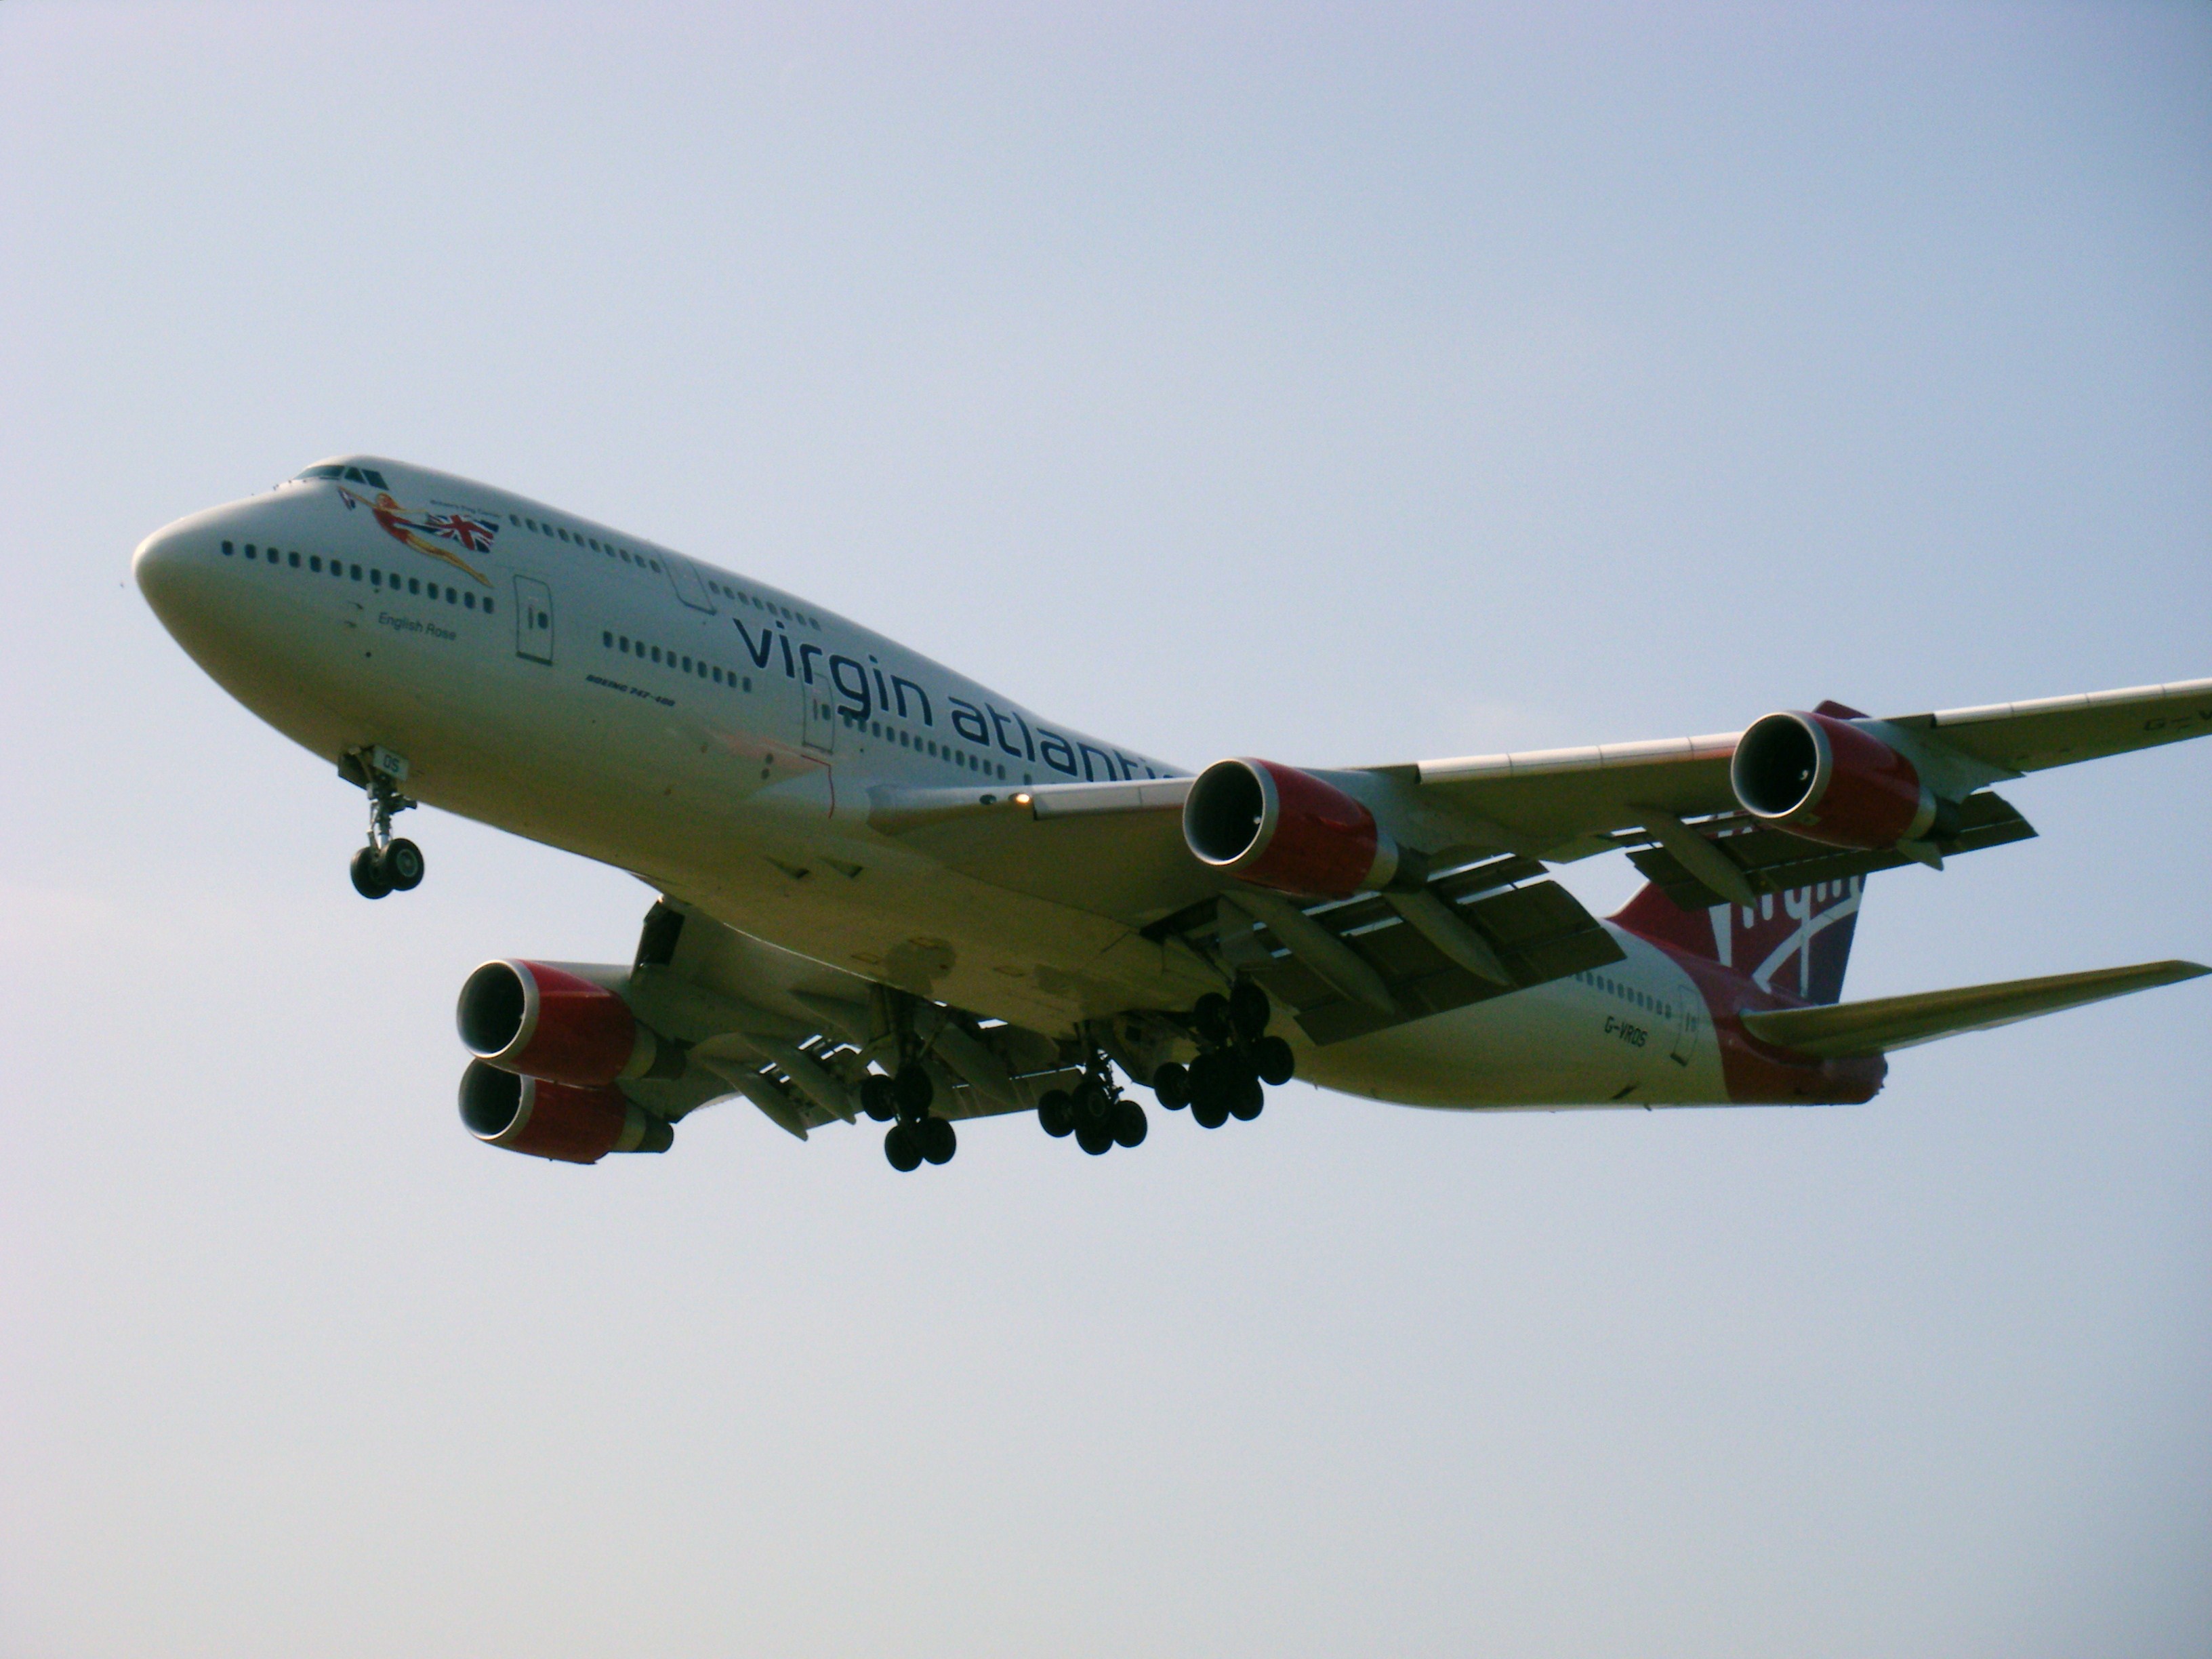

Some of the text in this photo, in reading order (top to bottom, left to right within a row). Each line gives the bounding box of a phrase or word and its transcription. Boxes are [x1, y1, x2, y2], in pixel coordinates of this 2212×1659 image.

[379, 611, 457, 640] English Rose
[733, 617, 933, 726] virgin
[586, 674, 675, 706] BOEING 747-400
[1605, 1016, 1648, 1047] G-VROS
